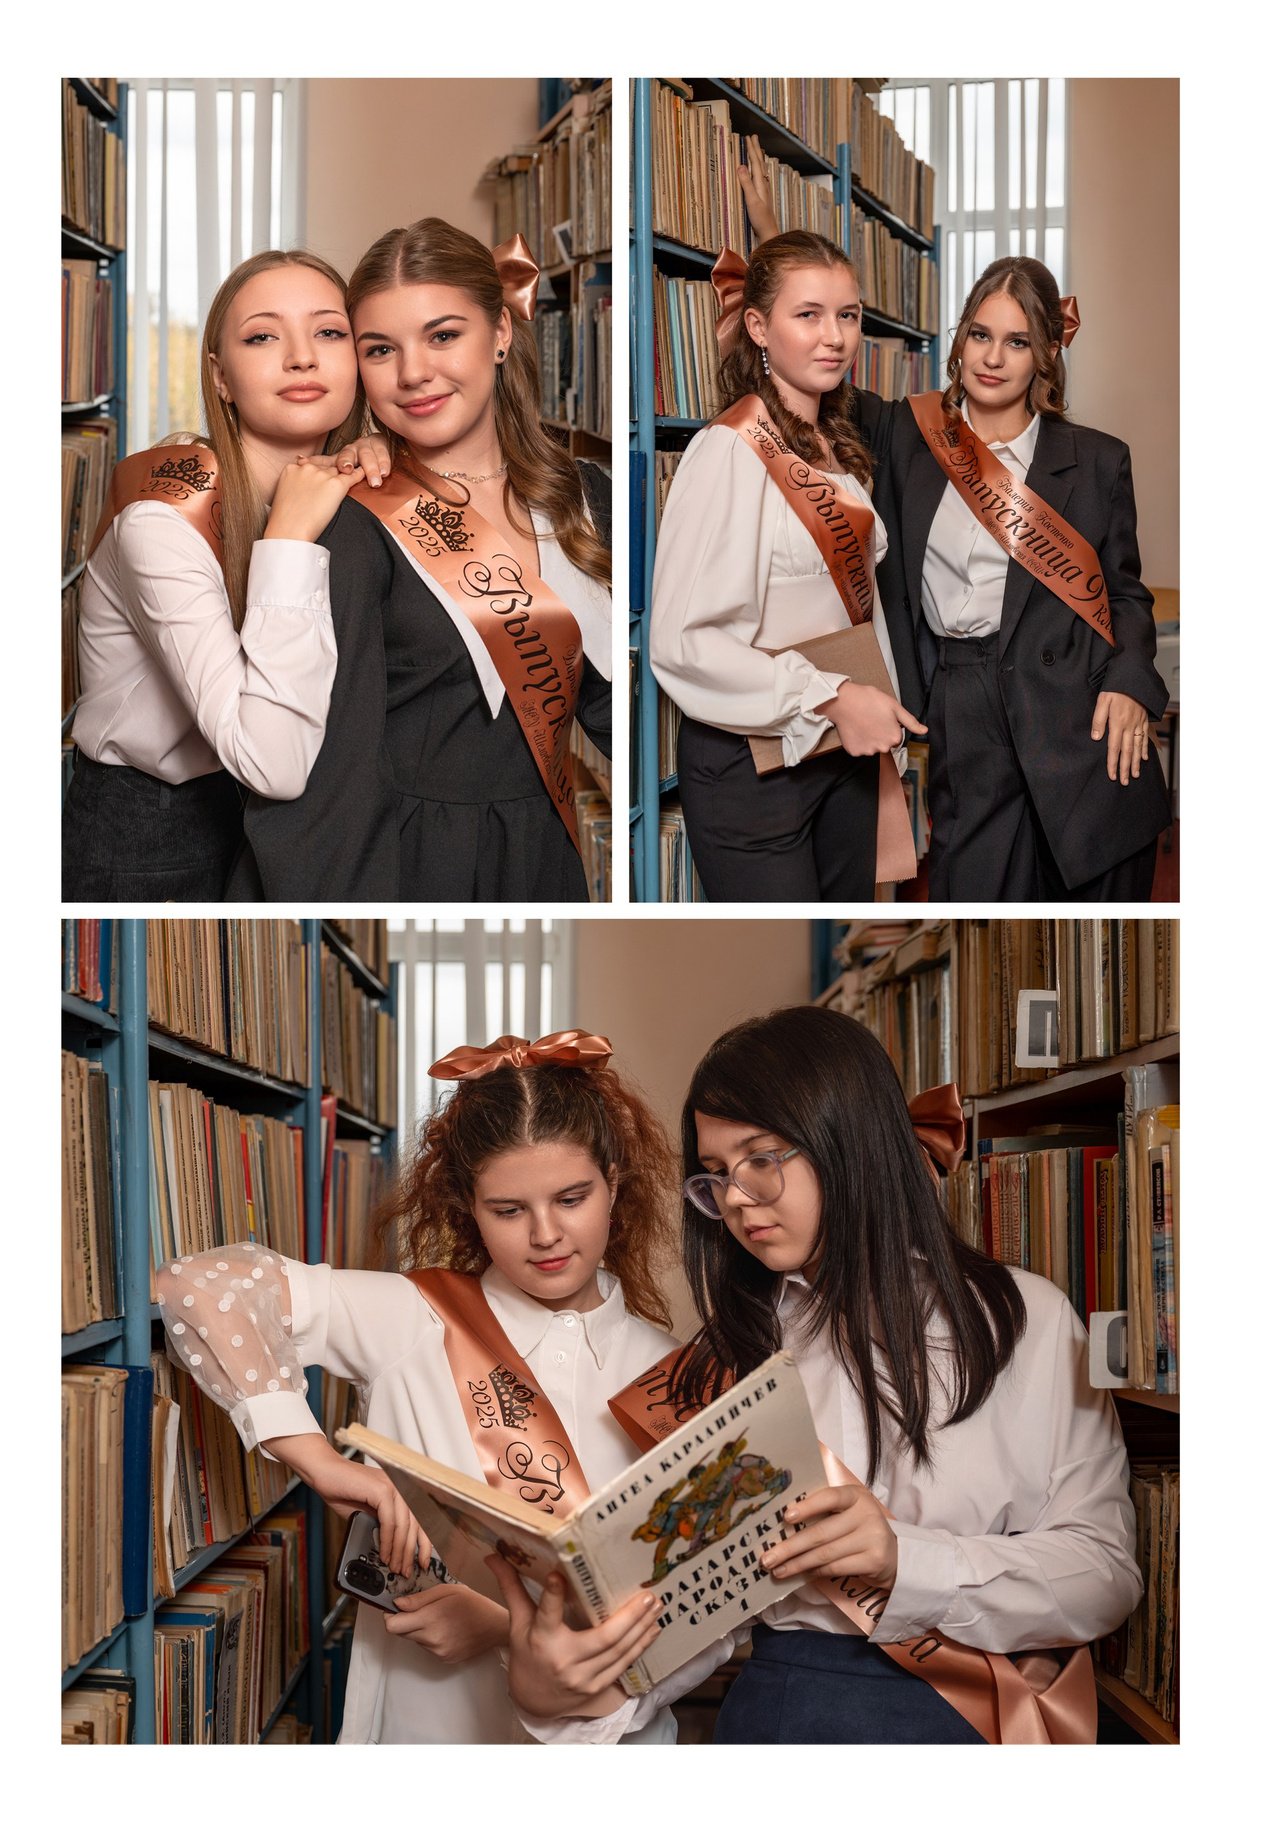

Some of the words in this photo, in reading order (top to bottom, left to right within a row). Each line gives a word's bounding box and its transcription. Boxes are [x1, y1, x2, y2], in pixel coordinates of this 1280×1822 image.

[746, 427, 780, 459] 2025
[928, 427, 947, 449] 2025
[138, 479, 195, 500] 2025
[944, 436, 1081, 584] Выпускница
[1069, 574, 1104, 602] 9
[997, 475, 1034, 514] Валерия
[1035, 511, 1075, 549] Костенко
[397, 516, 448, 558] 2025
[1155, 1168, 1163, 1207] СТИВЕНСОН
[466, 1380, 500, 1429] 2025
[593, 1474, 653, 1524] АНГЕЛ
[658, 1491, 808, 1606] ОЛГАРСКИЕ
[739, 1598, 751, 1614] 1
